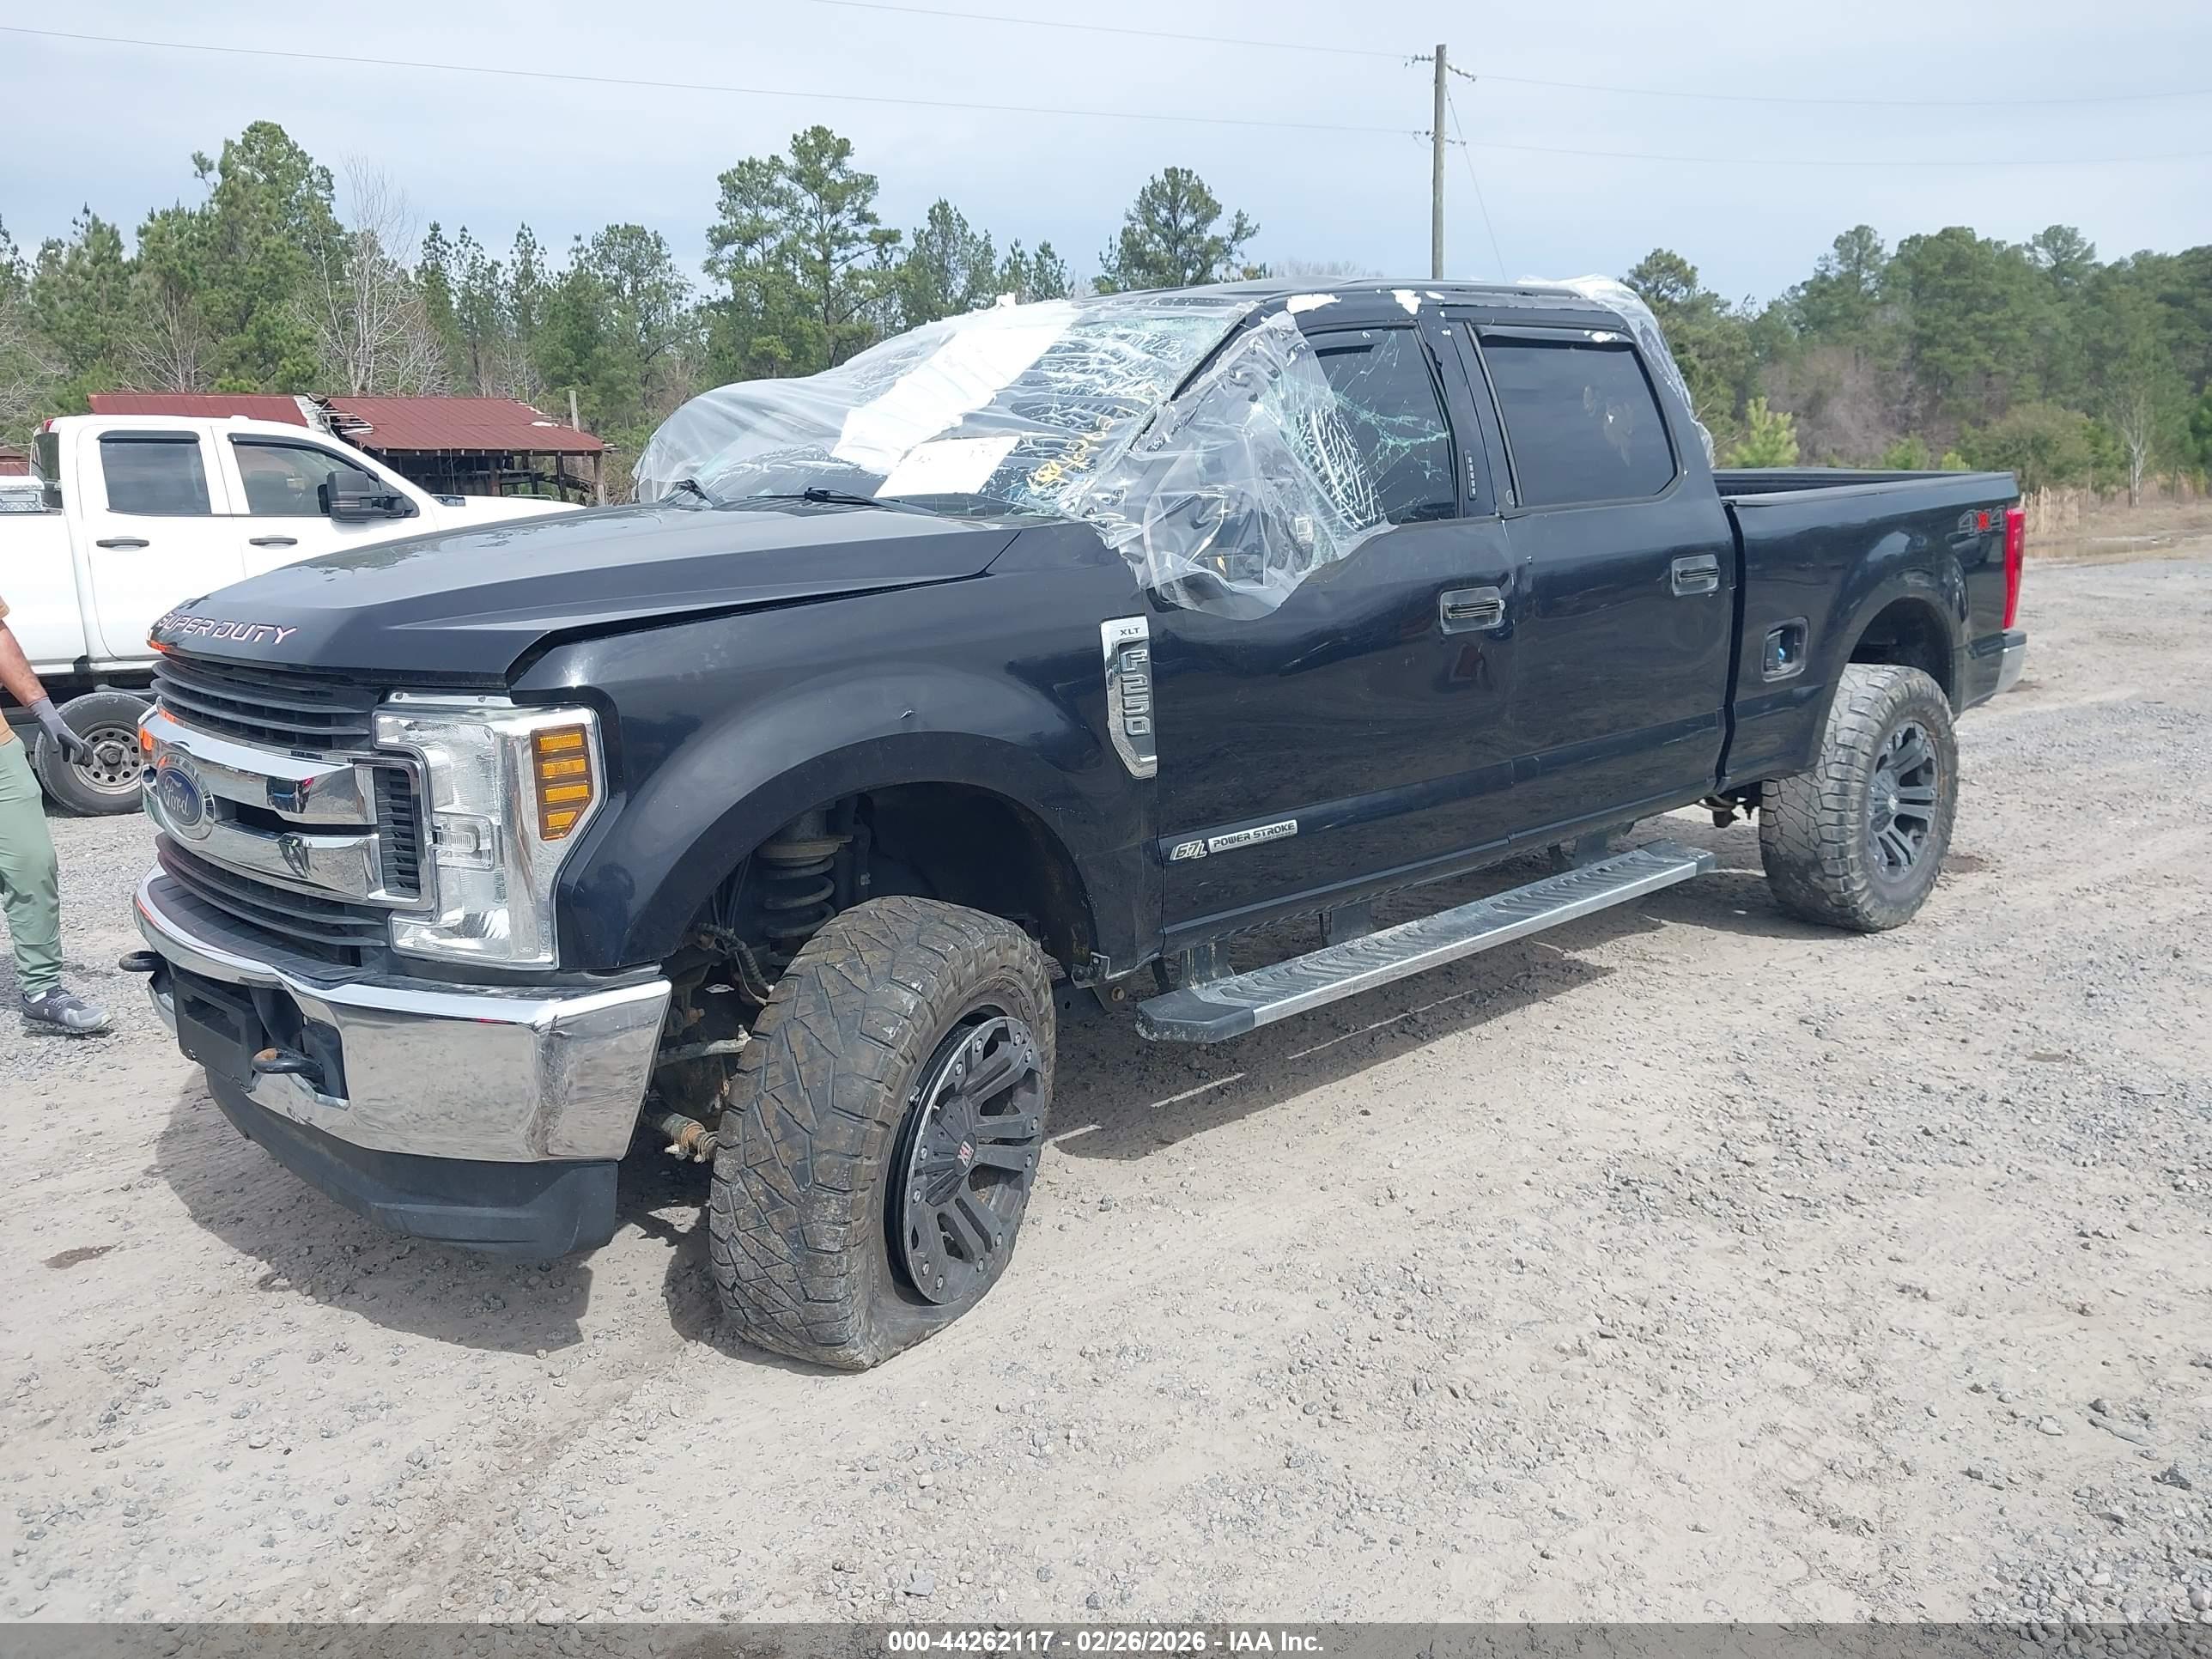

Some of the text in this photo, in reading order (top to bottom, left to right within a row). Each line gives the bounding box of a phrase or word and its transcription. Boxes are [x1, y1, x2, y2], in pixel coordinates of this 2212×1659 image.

[158, 611, 298, 645] SUPER DUTY
[1119, 626, 1141, 636] XLT
[163, 775, 190, 817] Ford
[1212, 833, 1251, 848] POWER
[1253, 822, 1295, 840] STROKE
